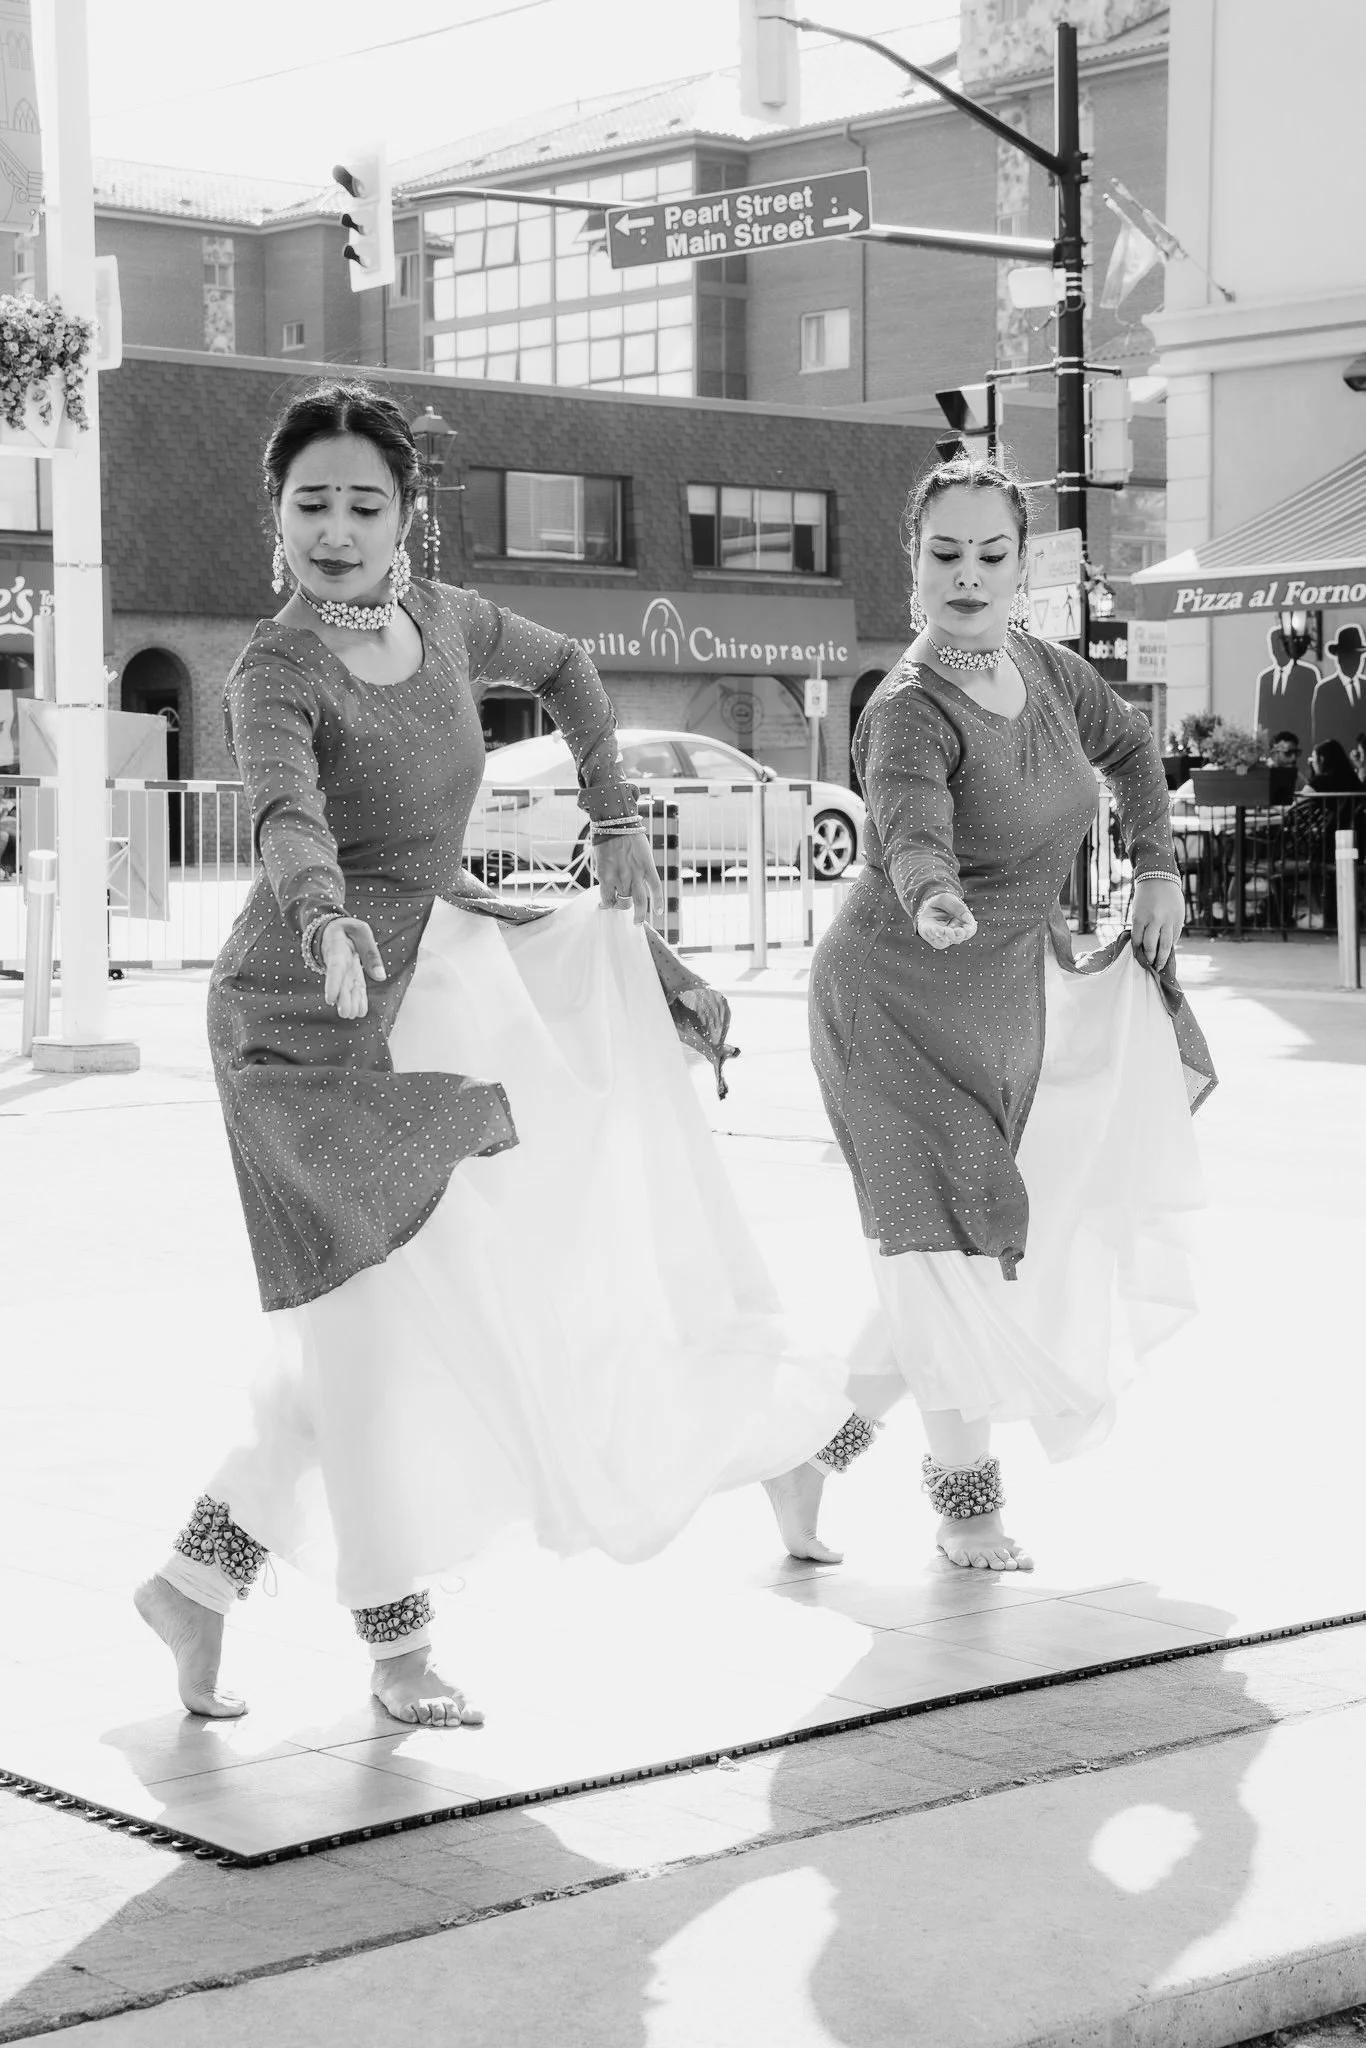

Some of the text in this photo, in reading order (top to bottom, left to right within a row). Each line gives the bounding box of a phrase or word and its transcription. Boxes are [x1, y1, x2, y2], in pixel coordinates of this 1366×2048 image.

[664, 185, 813, 230] Pearl Street
[665, 214, 815, 258] Main Street
[39, 589, 55, 606] To
[1173, 580, 1366, 614] Pizza al Forno
[581, 626, 849, 666] ville Chiropractic
